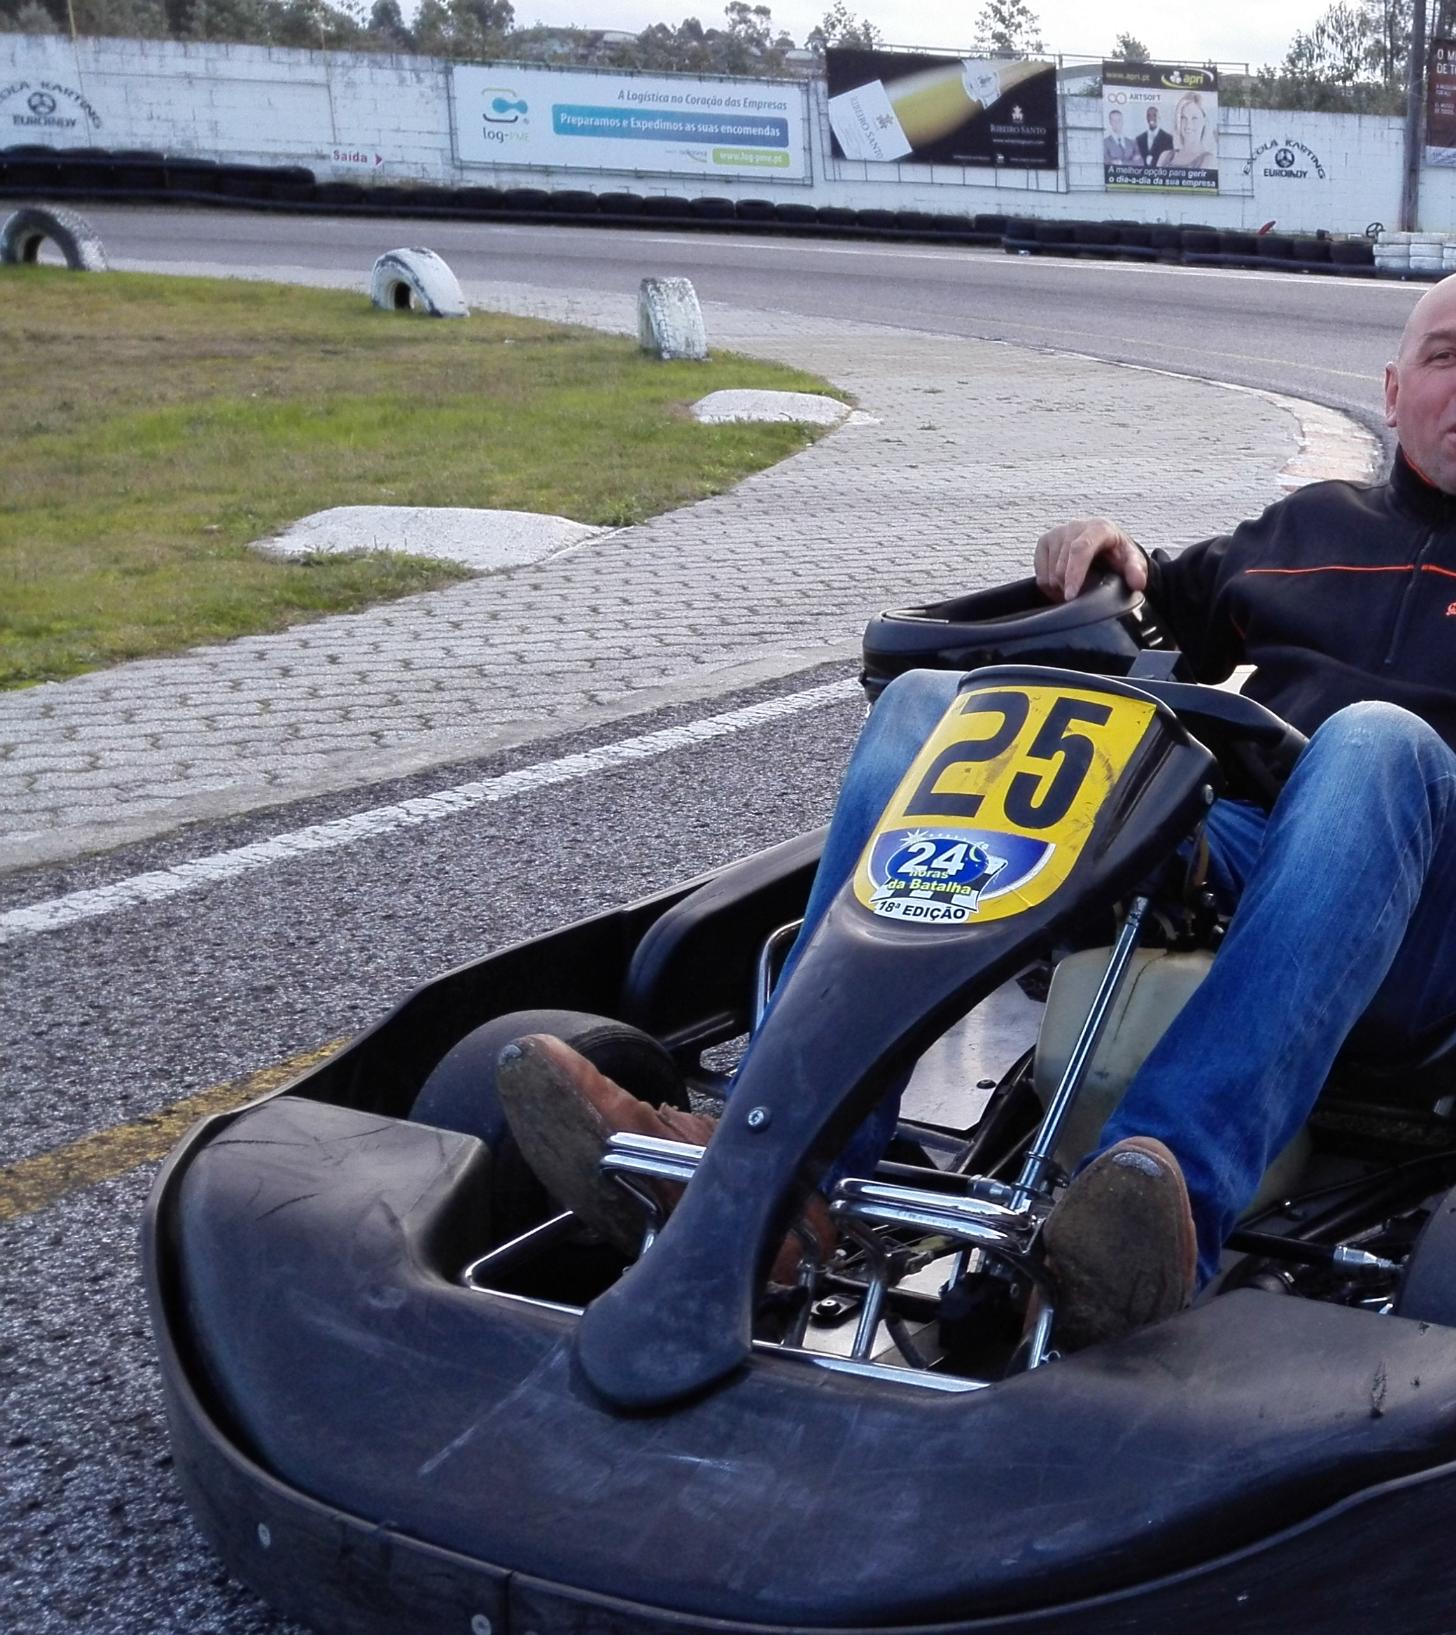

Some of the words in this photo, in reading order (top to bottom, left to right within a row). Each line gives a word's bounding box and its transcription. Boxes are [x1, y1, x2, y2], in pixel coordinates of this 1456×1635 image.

[1437, 49, 1444, 60] O
[1436, 63, 1448, 74] DE
[1183, 73, 1204, 86] apri
[617, 90, 625, 100] A
[627, 90, 669, 106] Logística
[671, 95, 683, 103] no
[685, 94, 722, 108] Coração
[724, 97, 741, 107] das
[743, 98, 788, 110] Empresas
[560, 112, 620, 129] Preparamos
[622, 119, 628, 128] e
[630, 117, 683, 132] Expedimos
[684, 123, 695, 132] as
[697, 124, 719, 133] suas
[721, 124, 781, 137] encomendas
[1285, 139, 1326, 179] KARTING
[1108, 165, 1115, 173] A
[1116, 166, 1143, 175] melhor
[1143, 167, 1167, 177] opção
[1168, 169, 1187, 178] para
[1187, 170, 1208, 179] gerir
[1263, 168, 1309, 178] EUROINDY
[1116, 176, 1151, 185] dia-a-dia
[1153, 177, 1164, 185] da
[1182, 180, 1216, 188] empresa
[903, 691, 1114, 829] 25
[897, 841, 970, 876] 24
[909, 867, 950, 879] horas
[887, 879, 905, 890] da
[909, 878, 972, 896] Batalha
[902, 904, 966, 922] EDIÇÃO
